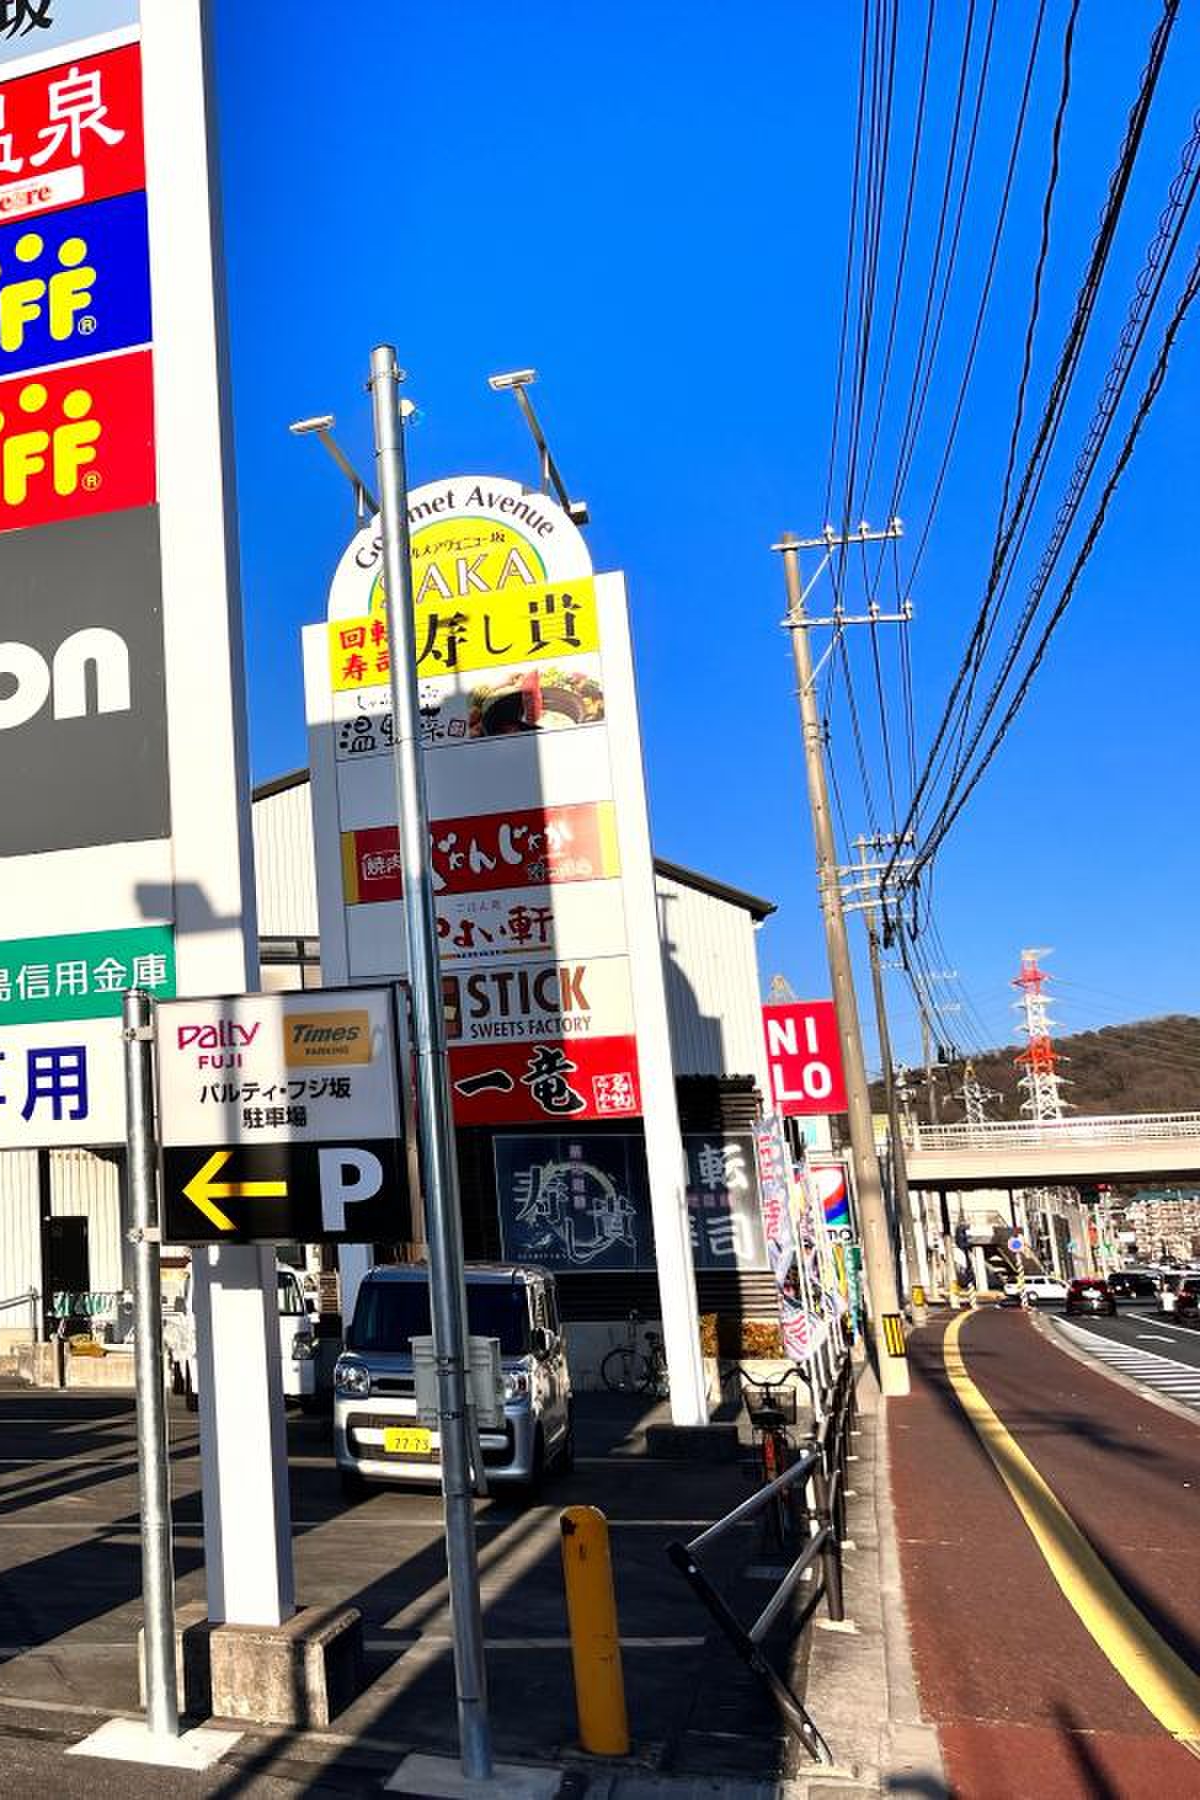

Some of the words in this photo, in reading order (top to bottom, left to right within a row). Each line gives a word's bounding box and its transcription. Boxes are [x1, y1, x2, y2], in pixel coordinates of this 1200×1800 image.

[355, 489, 457, 571] Gomet
[465, 485, 555, 539] Avenue
[379, 547, 537, 609] AKA
[466, 966, 591, 1019] STICK
[291, 1023, 361, 1044] Times
[470, 1021, 525, 1040] SWEETS
[529, 1015, 592, 1036] FACTORY
[198, 1053, 243, 1070] FUJI
[453, 1044, 588, 1116] 一竜
[200, 1076, 352, 1104] パルティ・フジ坂
[242, 1105, 308, 1130] 駐車場
[317, 1147, 384, 1232] P
